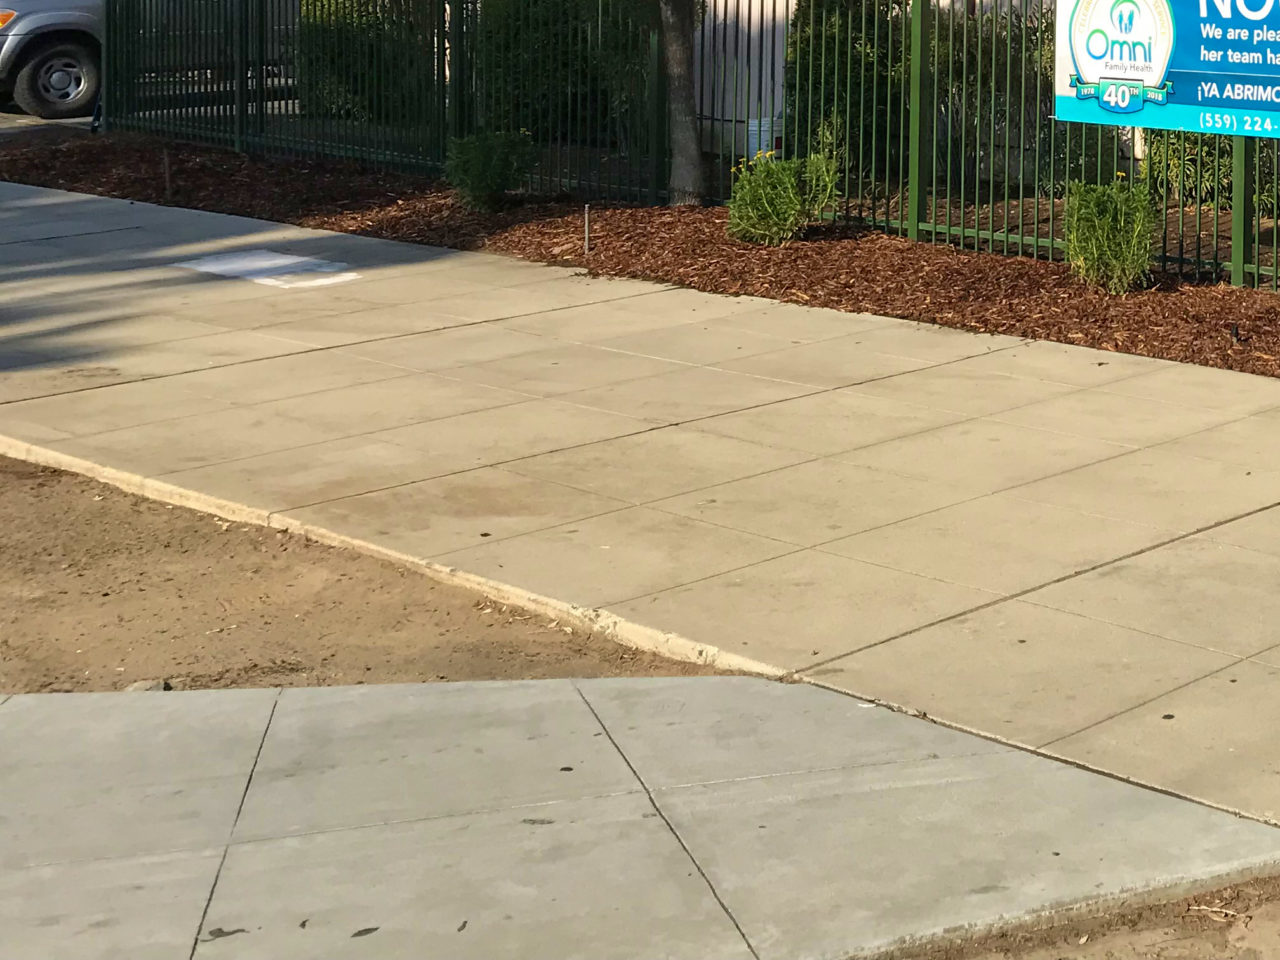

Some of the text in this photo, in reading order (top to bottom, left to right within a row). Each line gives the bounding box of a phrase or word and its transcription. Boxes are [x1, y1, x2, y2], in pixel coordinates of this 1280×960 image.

[1200, 23, 1222, 39] We
[1226, 28, 1249, 40] are
[1086, 29, 1152, 63] Omni
[1200, 45, 1223, 62] her
[1227, 49, 1262, 64] team
[1105, 62, 1153, 74] Family Health
[1197, 82, 1220, 101] ¡YA
[1199, 112, 1237, 132] (559)
